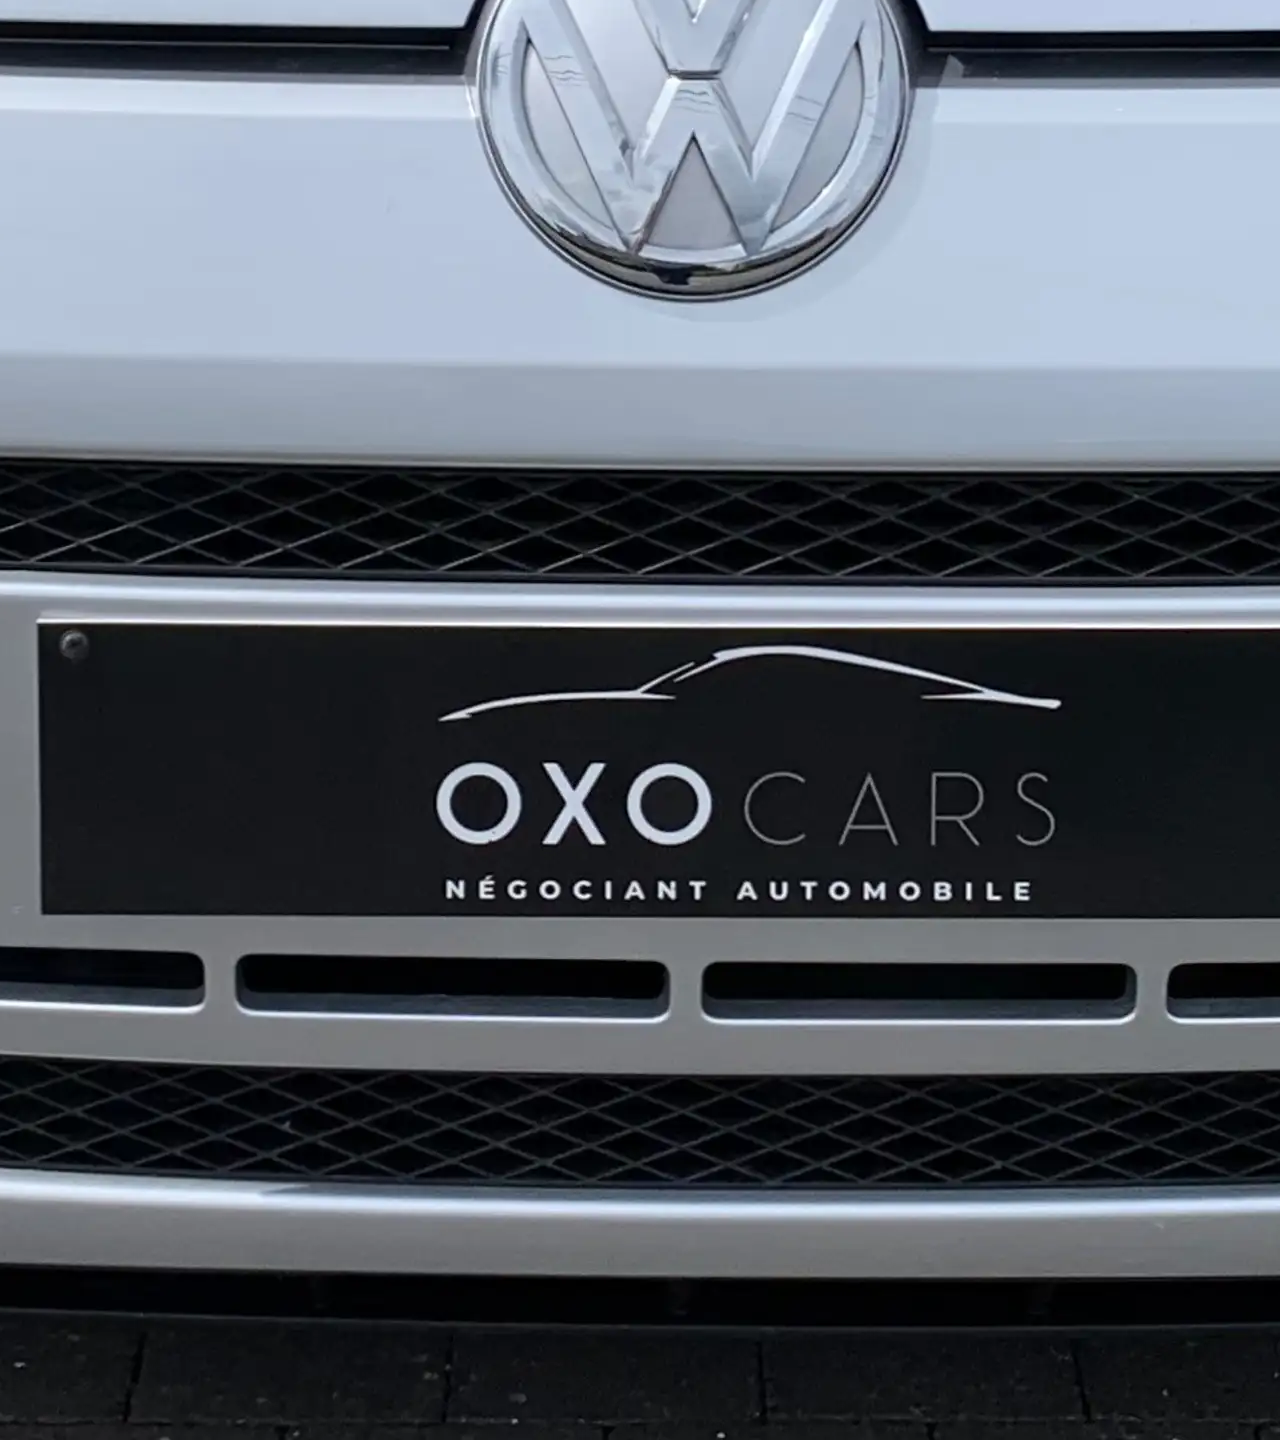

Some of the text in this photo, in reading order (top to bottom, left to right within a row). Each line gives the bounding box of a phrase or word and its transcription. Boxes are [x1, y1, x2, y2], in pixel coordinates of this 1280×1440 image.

[435, 761, 1058, 849] OXO CARS
[444, 873, 1034, 904] NÉGOCIANT AUTOMOBILE
